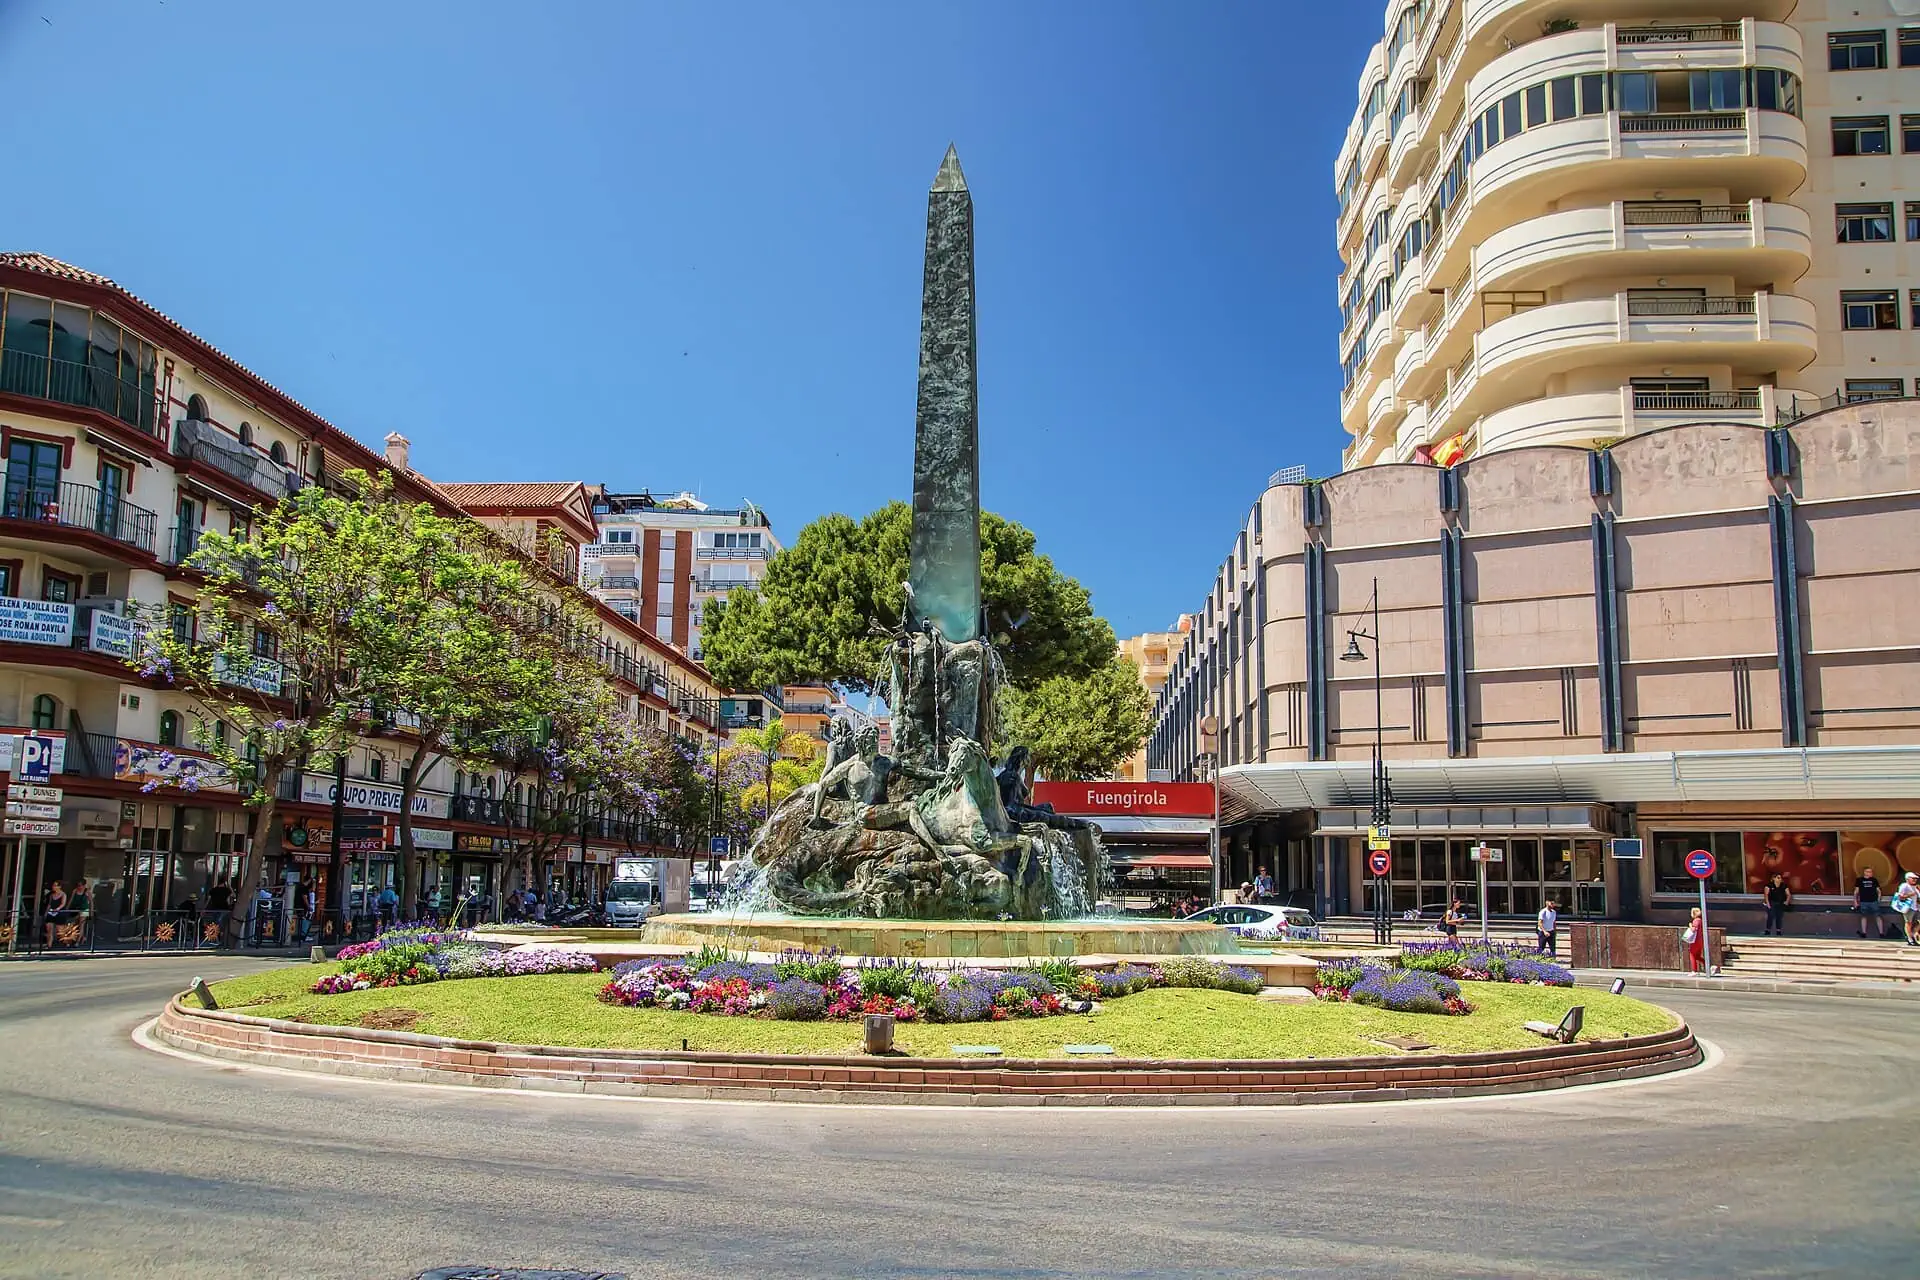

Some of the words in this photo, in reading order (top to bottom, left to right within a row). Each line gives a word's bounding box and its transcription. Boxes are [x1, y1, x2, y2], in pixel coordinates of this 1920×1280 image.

[22, 601, 50, 612] PADILLA
[52, 604, 69, 614] LEON
[14, 620, 40, 631] ROMAN
[41, 623, 66, 634] DAVILA
[30, 632, 57, 643] ADULTOS
[21, 739, 42, 774] P
[33, 788, 57, 797] DUNNES
[328, 784, 367, 805] GUPO
[368, 789, 428, 813] PREVEIVA
[1087, 790, 1167, 808] Fuengirola
[360, 841, 380, 849] KFC
